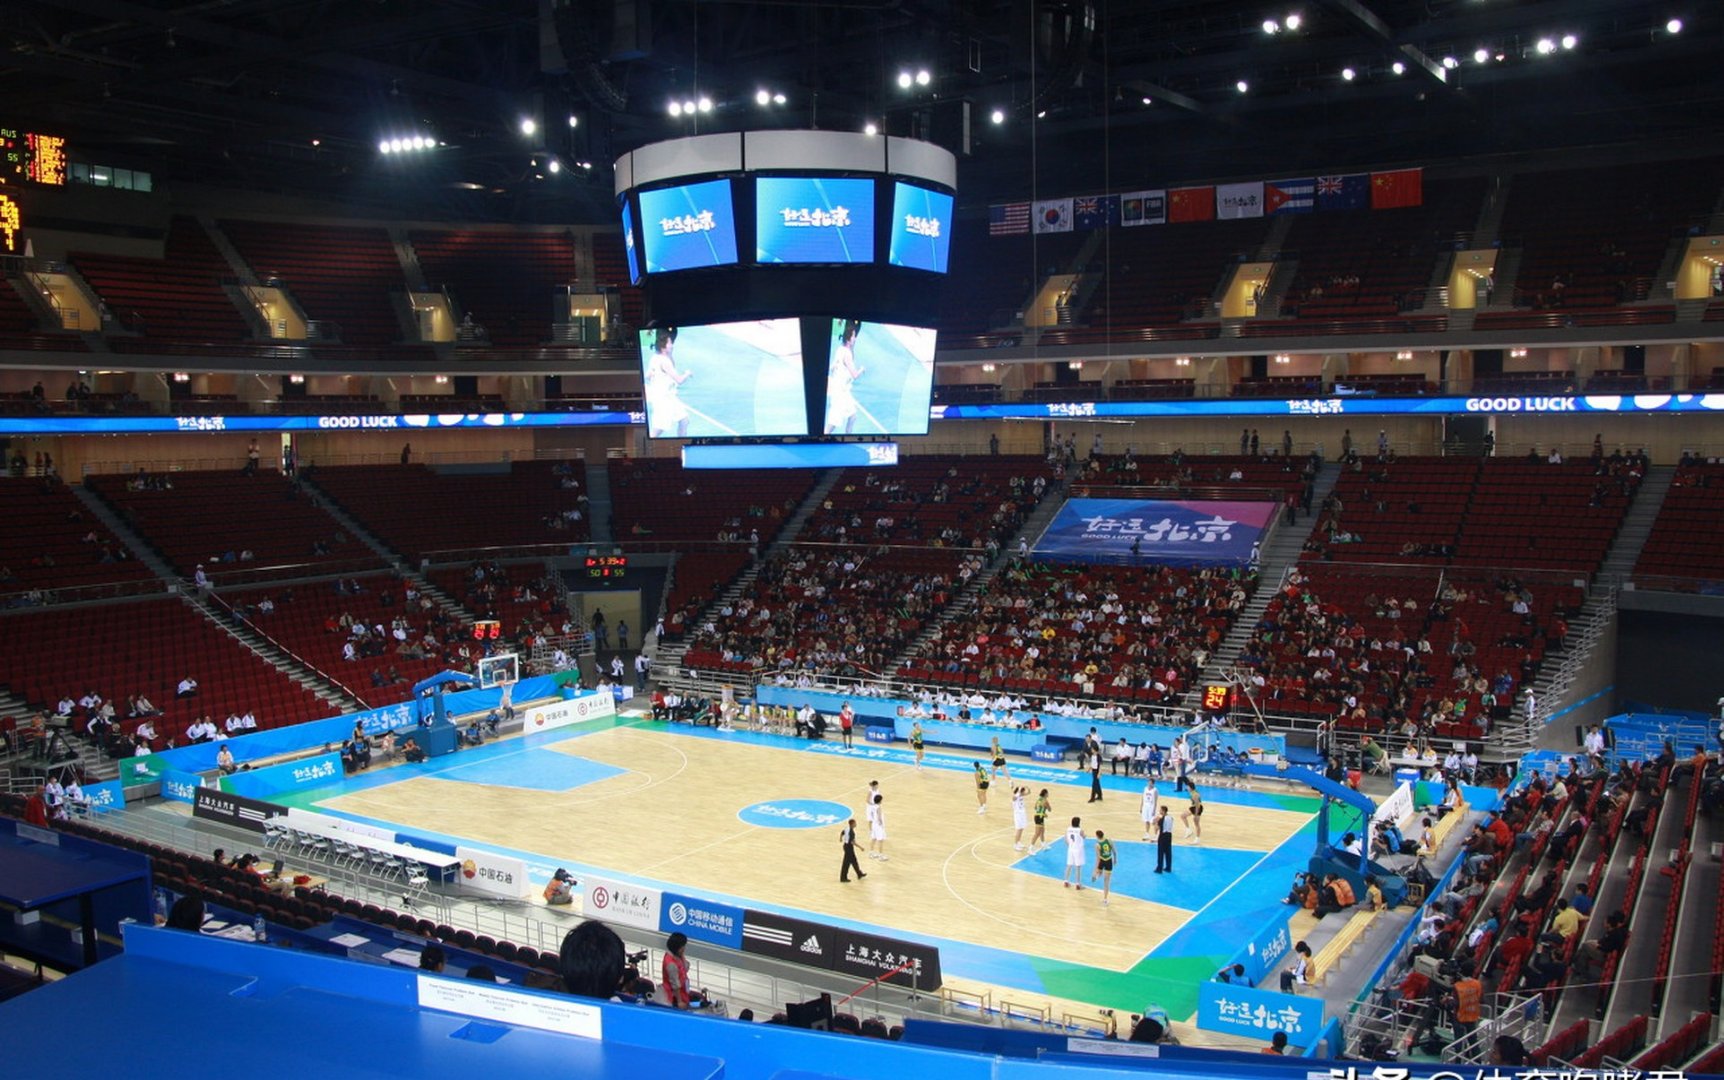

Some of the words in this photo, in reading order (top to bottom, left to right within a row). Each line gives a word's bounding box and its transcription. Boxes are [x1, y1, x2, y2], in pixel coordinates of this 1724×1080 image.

[1466, 397, 1521, 411] GOOD
[1525, 396, 1575, 411] LUCK
[318, 416, 359, 428] GOOD
[362, 416, 398, 427] LUCK
[1081, 515, 1238, 542] 好运北京
[1206, 694, 1223, 706] 24
[479, 867, 513, 884] 中国石油
[612, 891, 650, 910] 中国银行
[688, 909, 734, 927] 中国移动通信
[688, 920, 708, 930] CHINA
[709, 923, 733, 936] MOBILE
[845, 955, 877, 967] SHANGHAI
[846, 944, 922, 969] 上海大众汽车
[1214, 997, 1302, 1033] 好运北京
